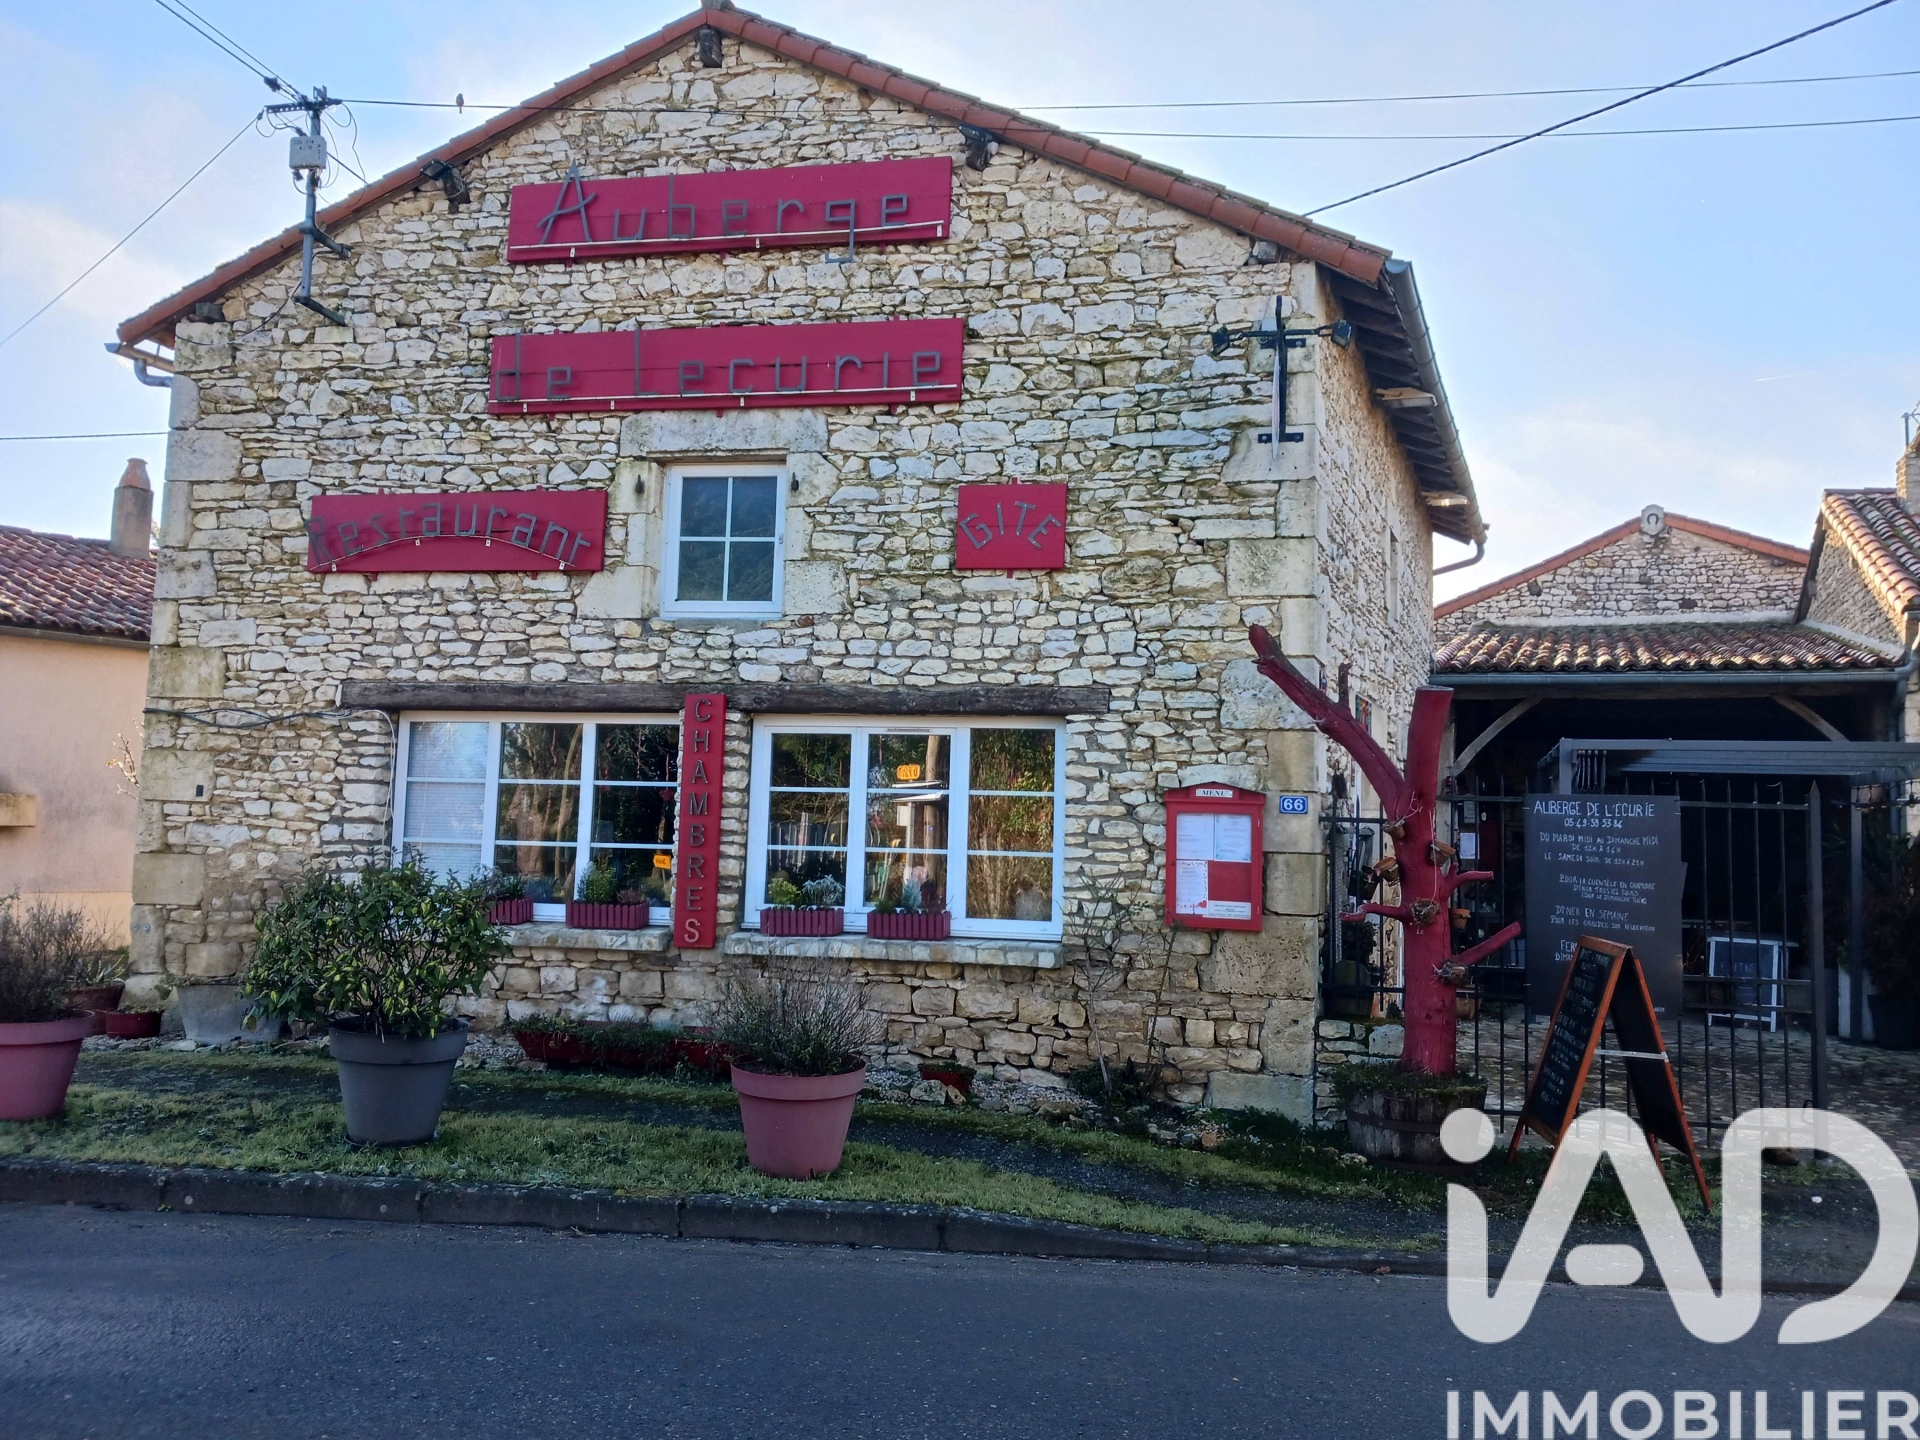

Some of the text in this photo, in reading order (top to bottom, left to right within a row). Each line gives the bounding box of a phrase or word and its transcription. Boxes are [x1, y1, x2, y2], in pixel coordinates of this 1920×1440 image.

[537, 158, 908, 263] Auberge
[495, 331, 571, 401] de
[960, 501, 1063, 550] GITE
[302, 501, 592, 566] Restaurant
[1202, 789, 1227, 797] MENU
[1283, 798, 1304, 811] 66
[1533, 800, 1582, 815] AUBERGE
[1586, 802, 1600, 816] DE
[683, 697, 712, 943] CHAMBRES
[1540, 831, 1550, 842] DU
[1552, 833, 1575, 842] MARDI
[1578, 834, 1593, 844] MIDI
[1606, 835, 1641, 845] DIMANCHE
[1642, 835, 1659, 846] MIDI
[1571, 843, 1581, 851] DE
[1544, 852, 1552, 860] LE
[1558, 853, 1583, 862] SAMEDI
[1559, 874, 1578, 883] POUR
[1584, 907, 1596, 918] EN
[1598, 909, 1630, 921] SEMAINE
[1568, 918, 1580, 926] LES
